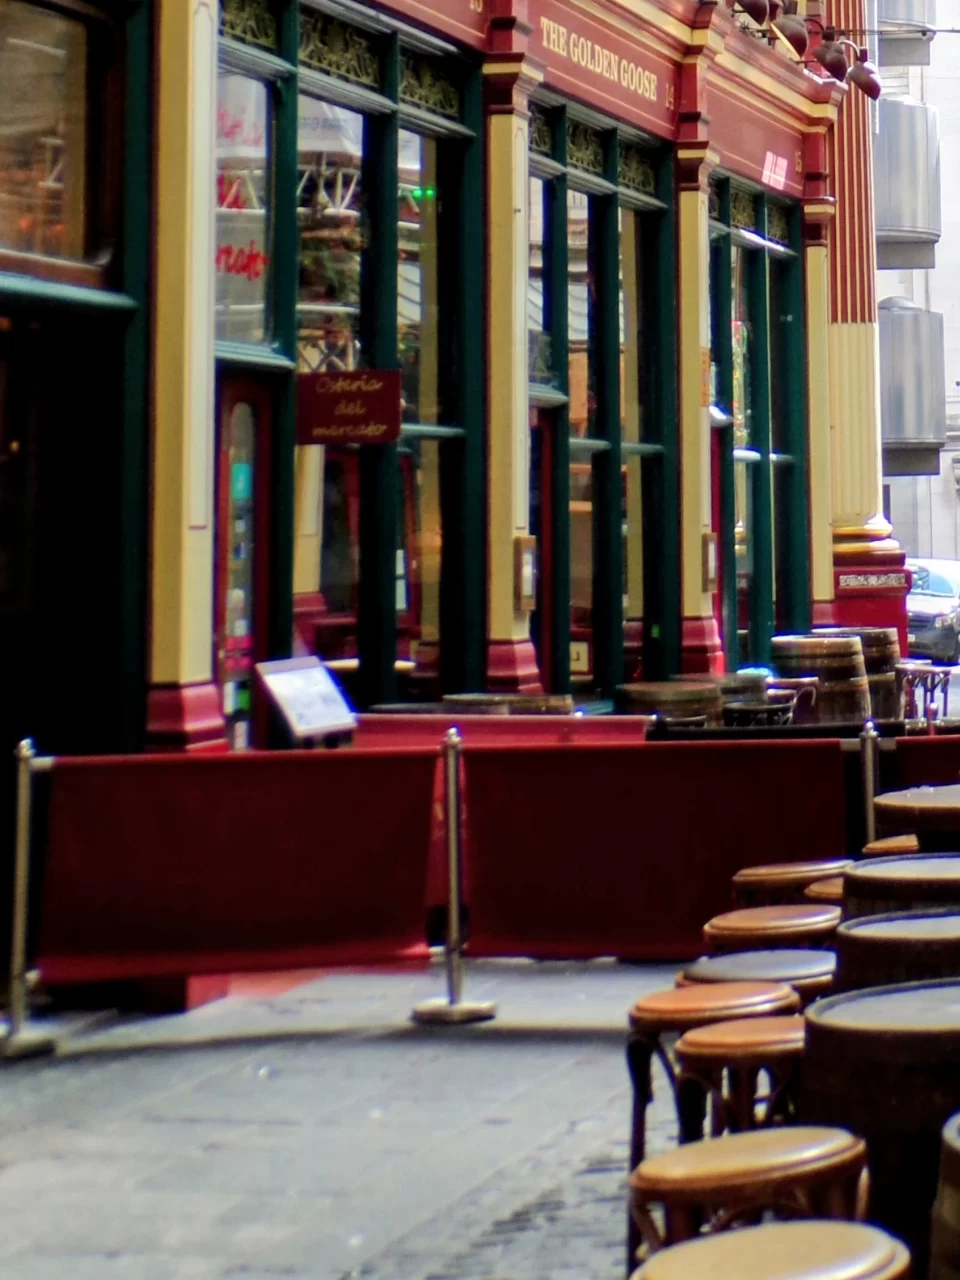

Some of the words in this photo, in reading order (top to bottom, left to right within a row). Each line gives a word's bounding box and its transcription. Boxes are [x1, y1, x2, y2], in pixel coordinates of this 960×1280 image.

[540, 15, 568, 57] THE
[570, 32, 619, 82] GOLDEN
[620, 59, 658, 102] GOOSE
[665, 81, 675, 110] 14
